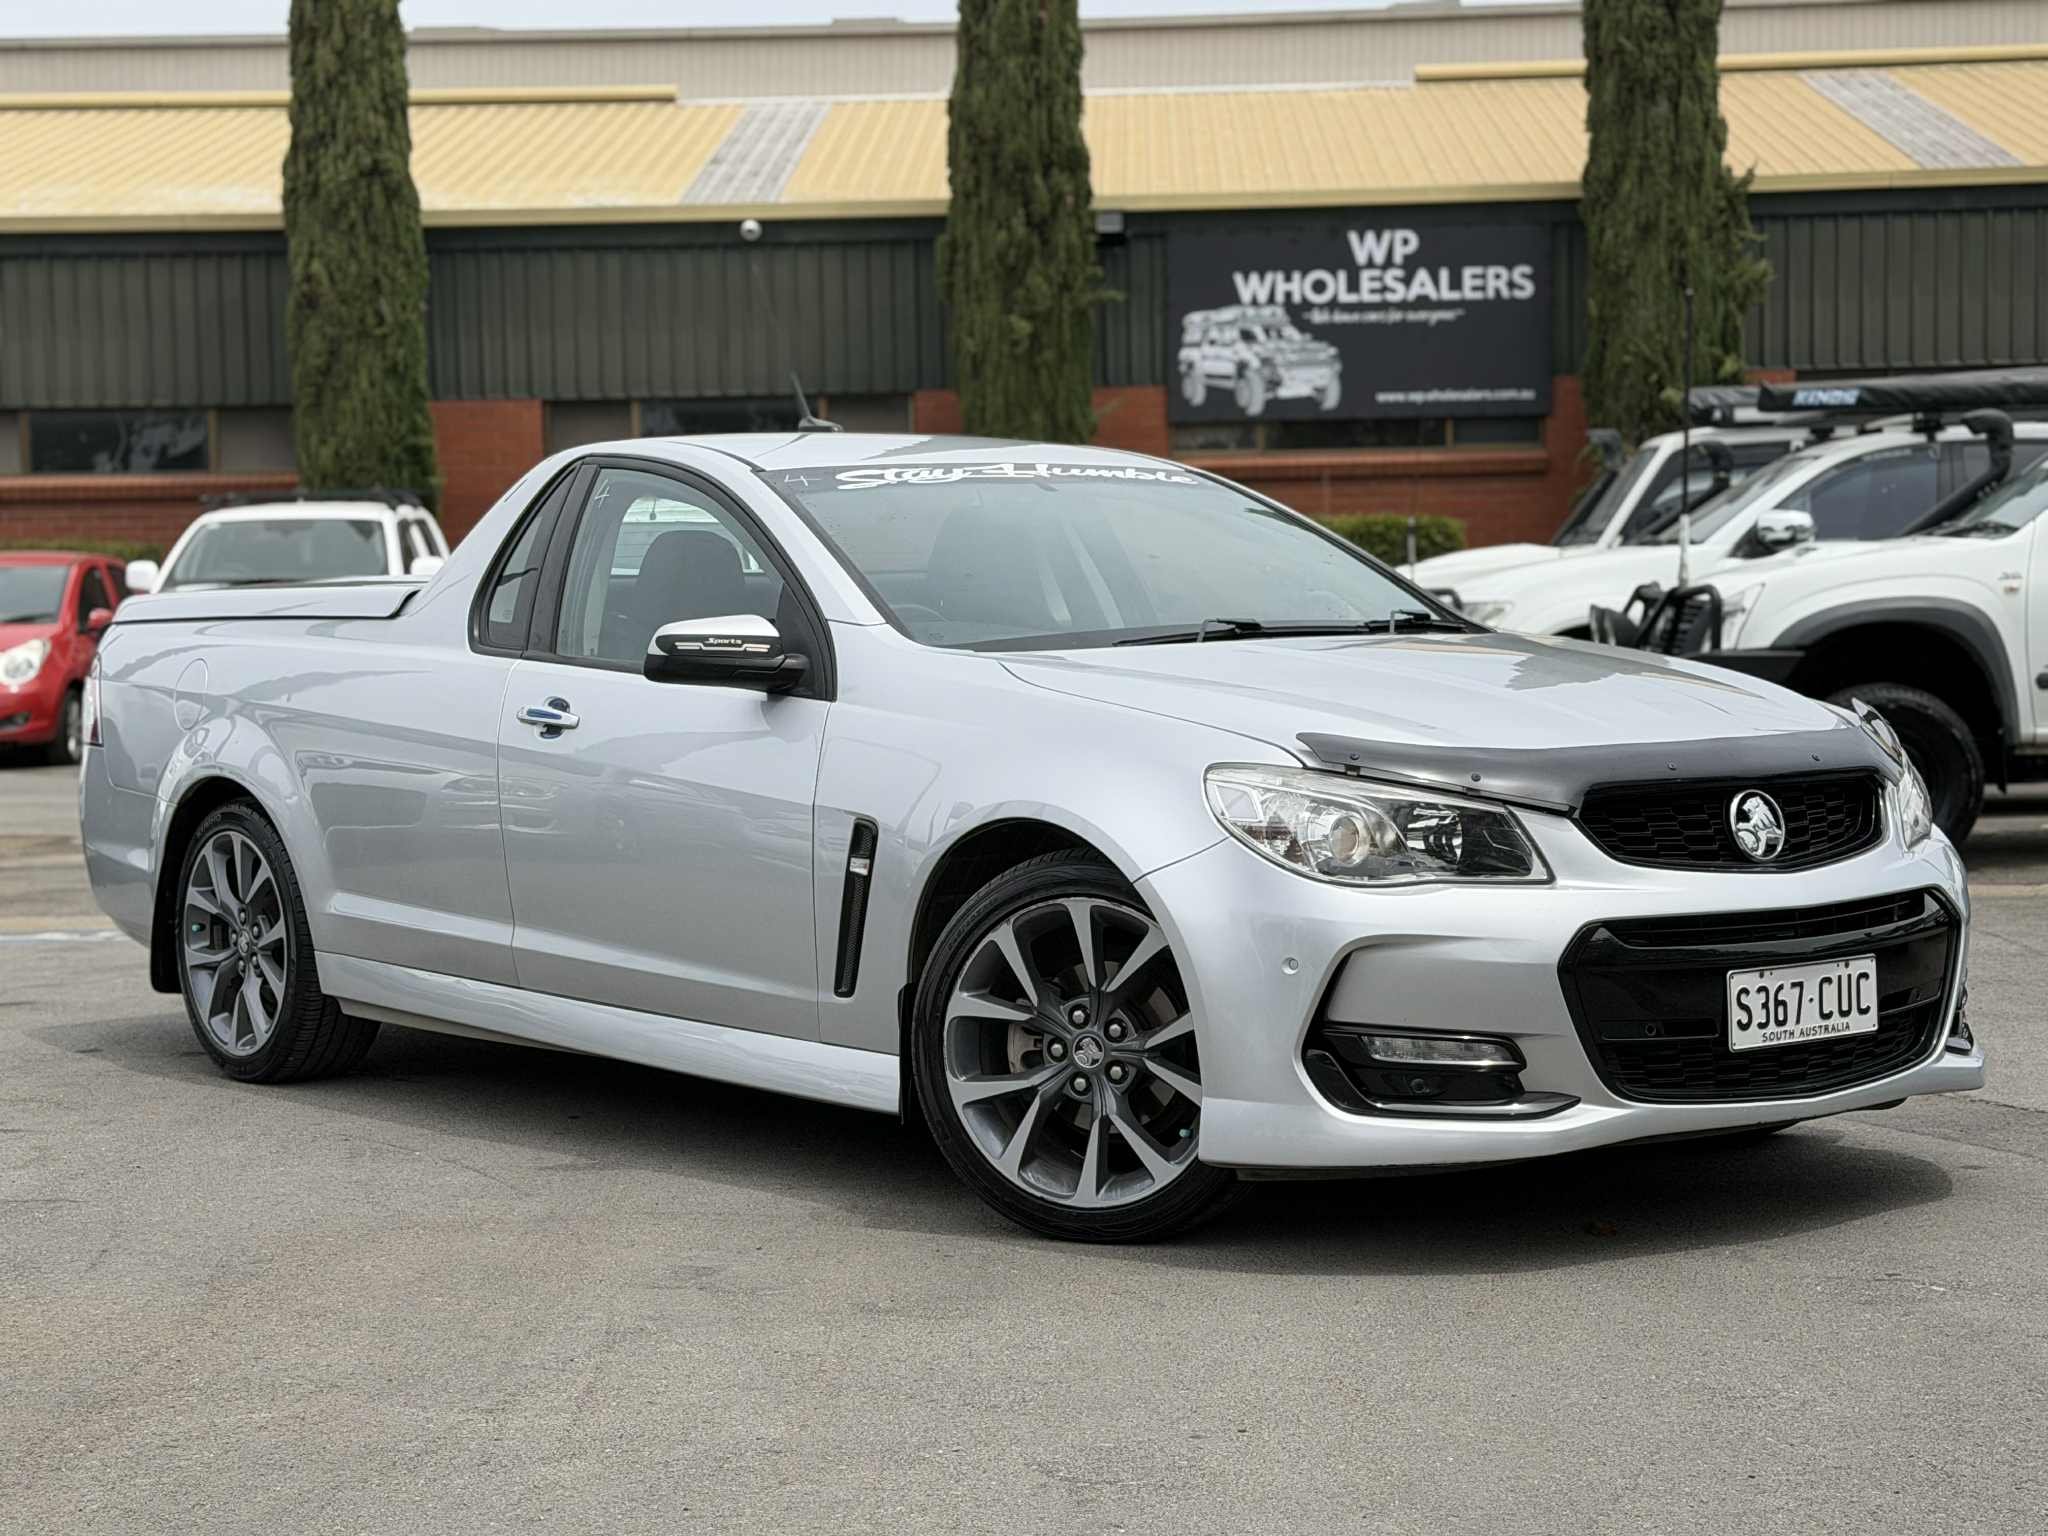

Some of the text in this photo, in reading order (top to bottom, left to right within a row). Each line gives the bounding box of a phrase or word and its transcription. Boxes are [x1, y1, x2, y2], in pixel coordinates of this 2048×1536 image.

[1346, 228, 1420, 267] WP
[1232, 265, 1535, 306] WHOLESALERS
[703, 637, 742, 645] Sports
[1762, 1021, 1851, 1043] SOUTH AUSTRALIA
